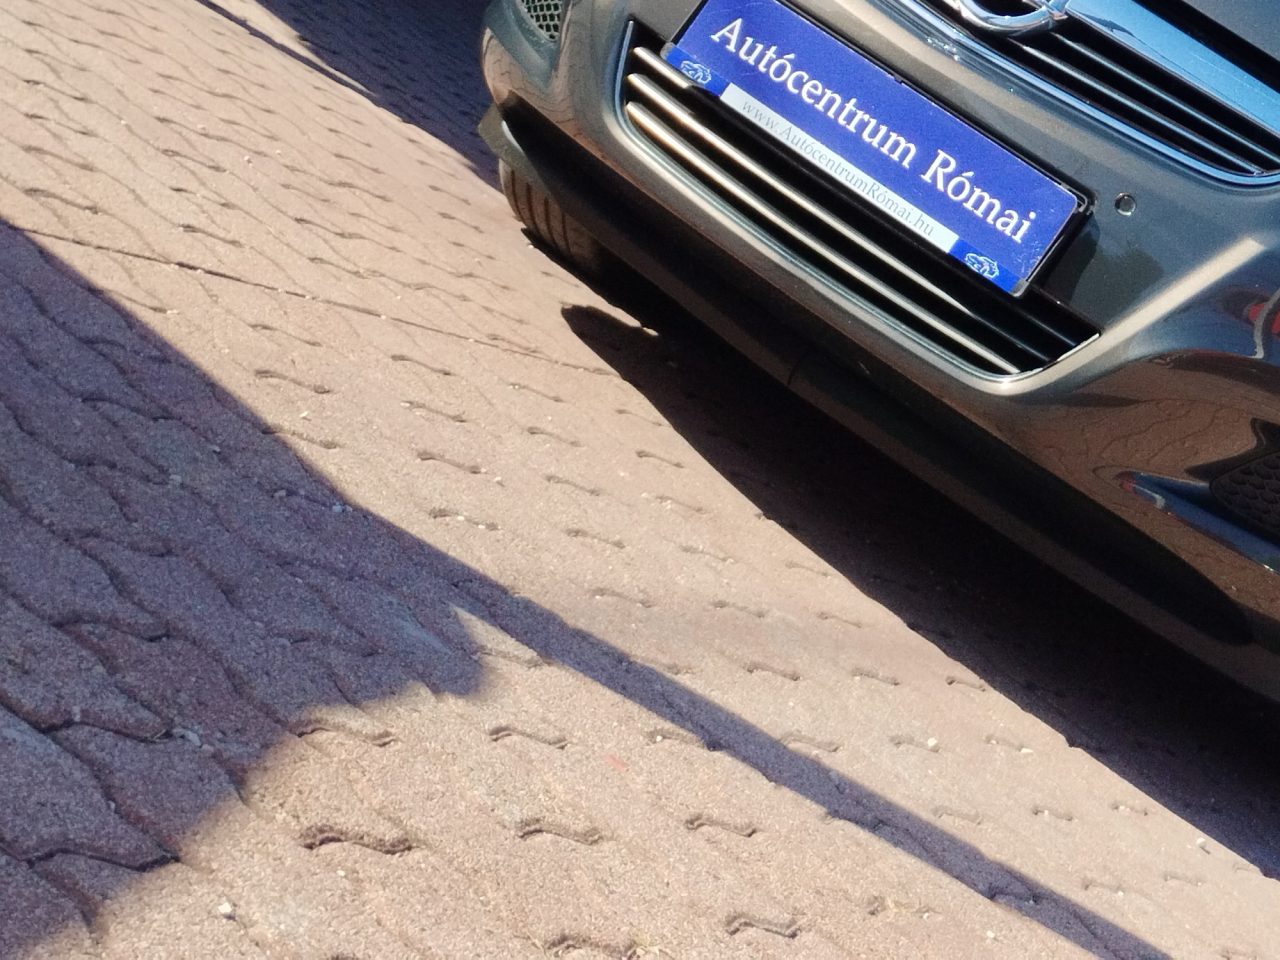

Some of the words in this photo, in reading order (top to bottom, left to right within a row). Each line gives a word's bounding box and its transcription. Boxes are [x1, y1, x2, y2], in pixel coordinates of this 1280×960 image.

[711, 16, 917, 170] Autócentrum
[921, 148, 1038, 245] Római
[741, 100, 935, 238] www.AutócentrumRómai.hu
